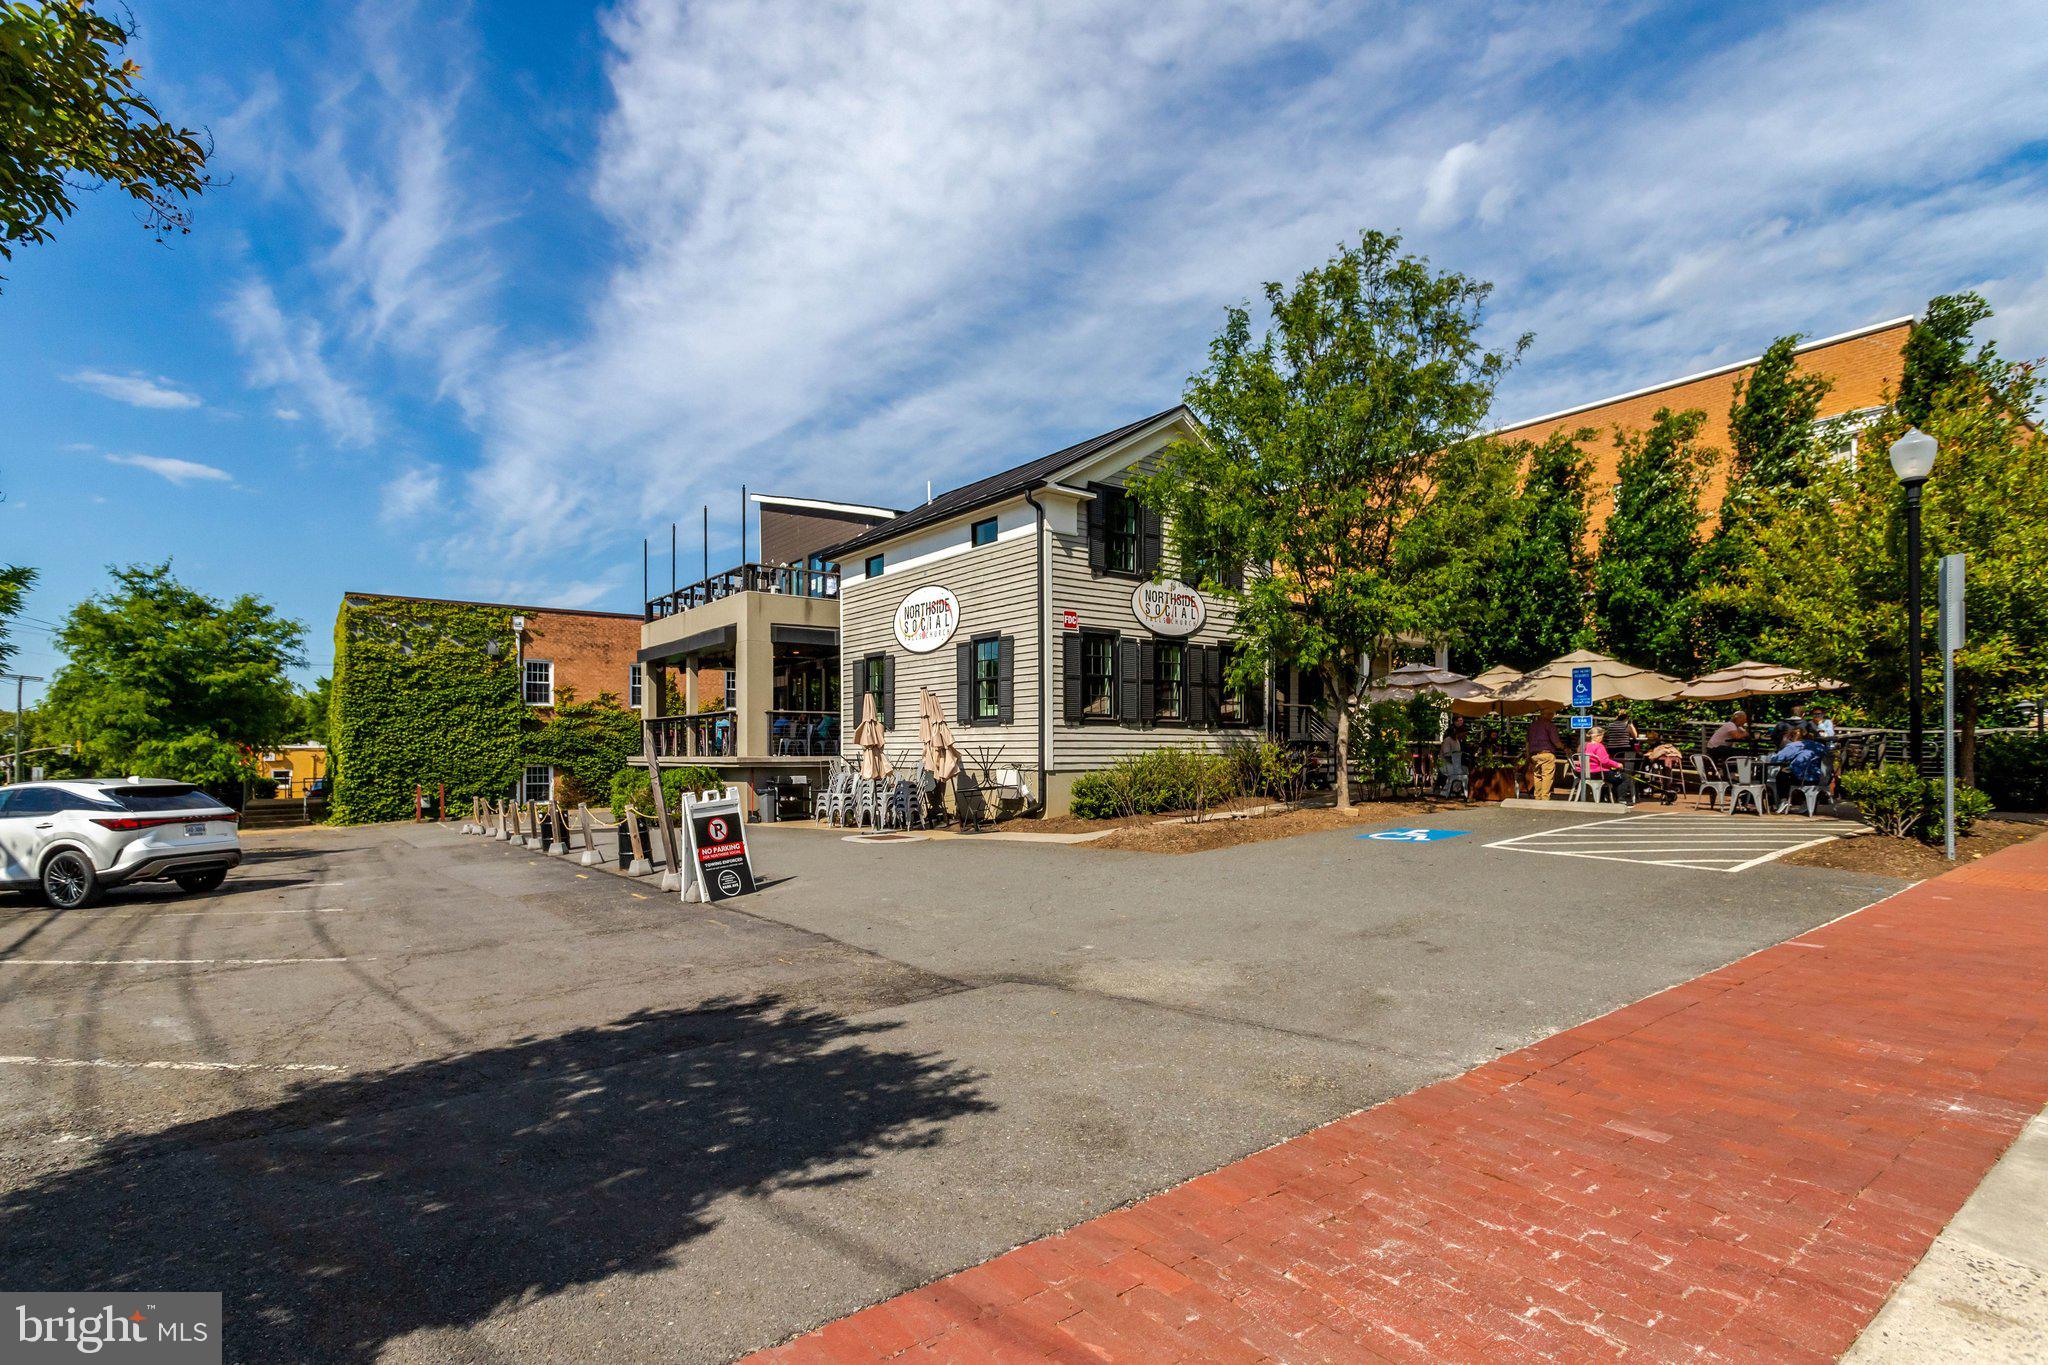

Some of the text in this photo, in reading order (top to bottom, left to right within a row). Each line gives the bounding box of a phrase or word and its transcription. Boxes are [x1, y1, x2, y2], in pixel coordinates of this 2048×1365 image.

[1145, 589, 1196, 608] NORTHSIDE
[904, 598, 950, 620] NORTHSIDE
[1145, 602, 1196, 620] SOCIAL
[904, 613, 950, 634] SOCIAL
[713, 844, 740, 853] PARKING
